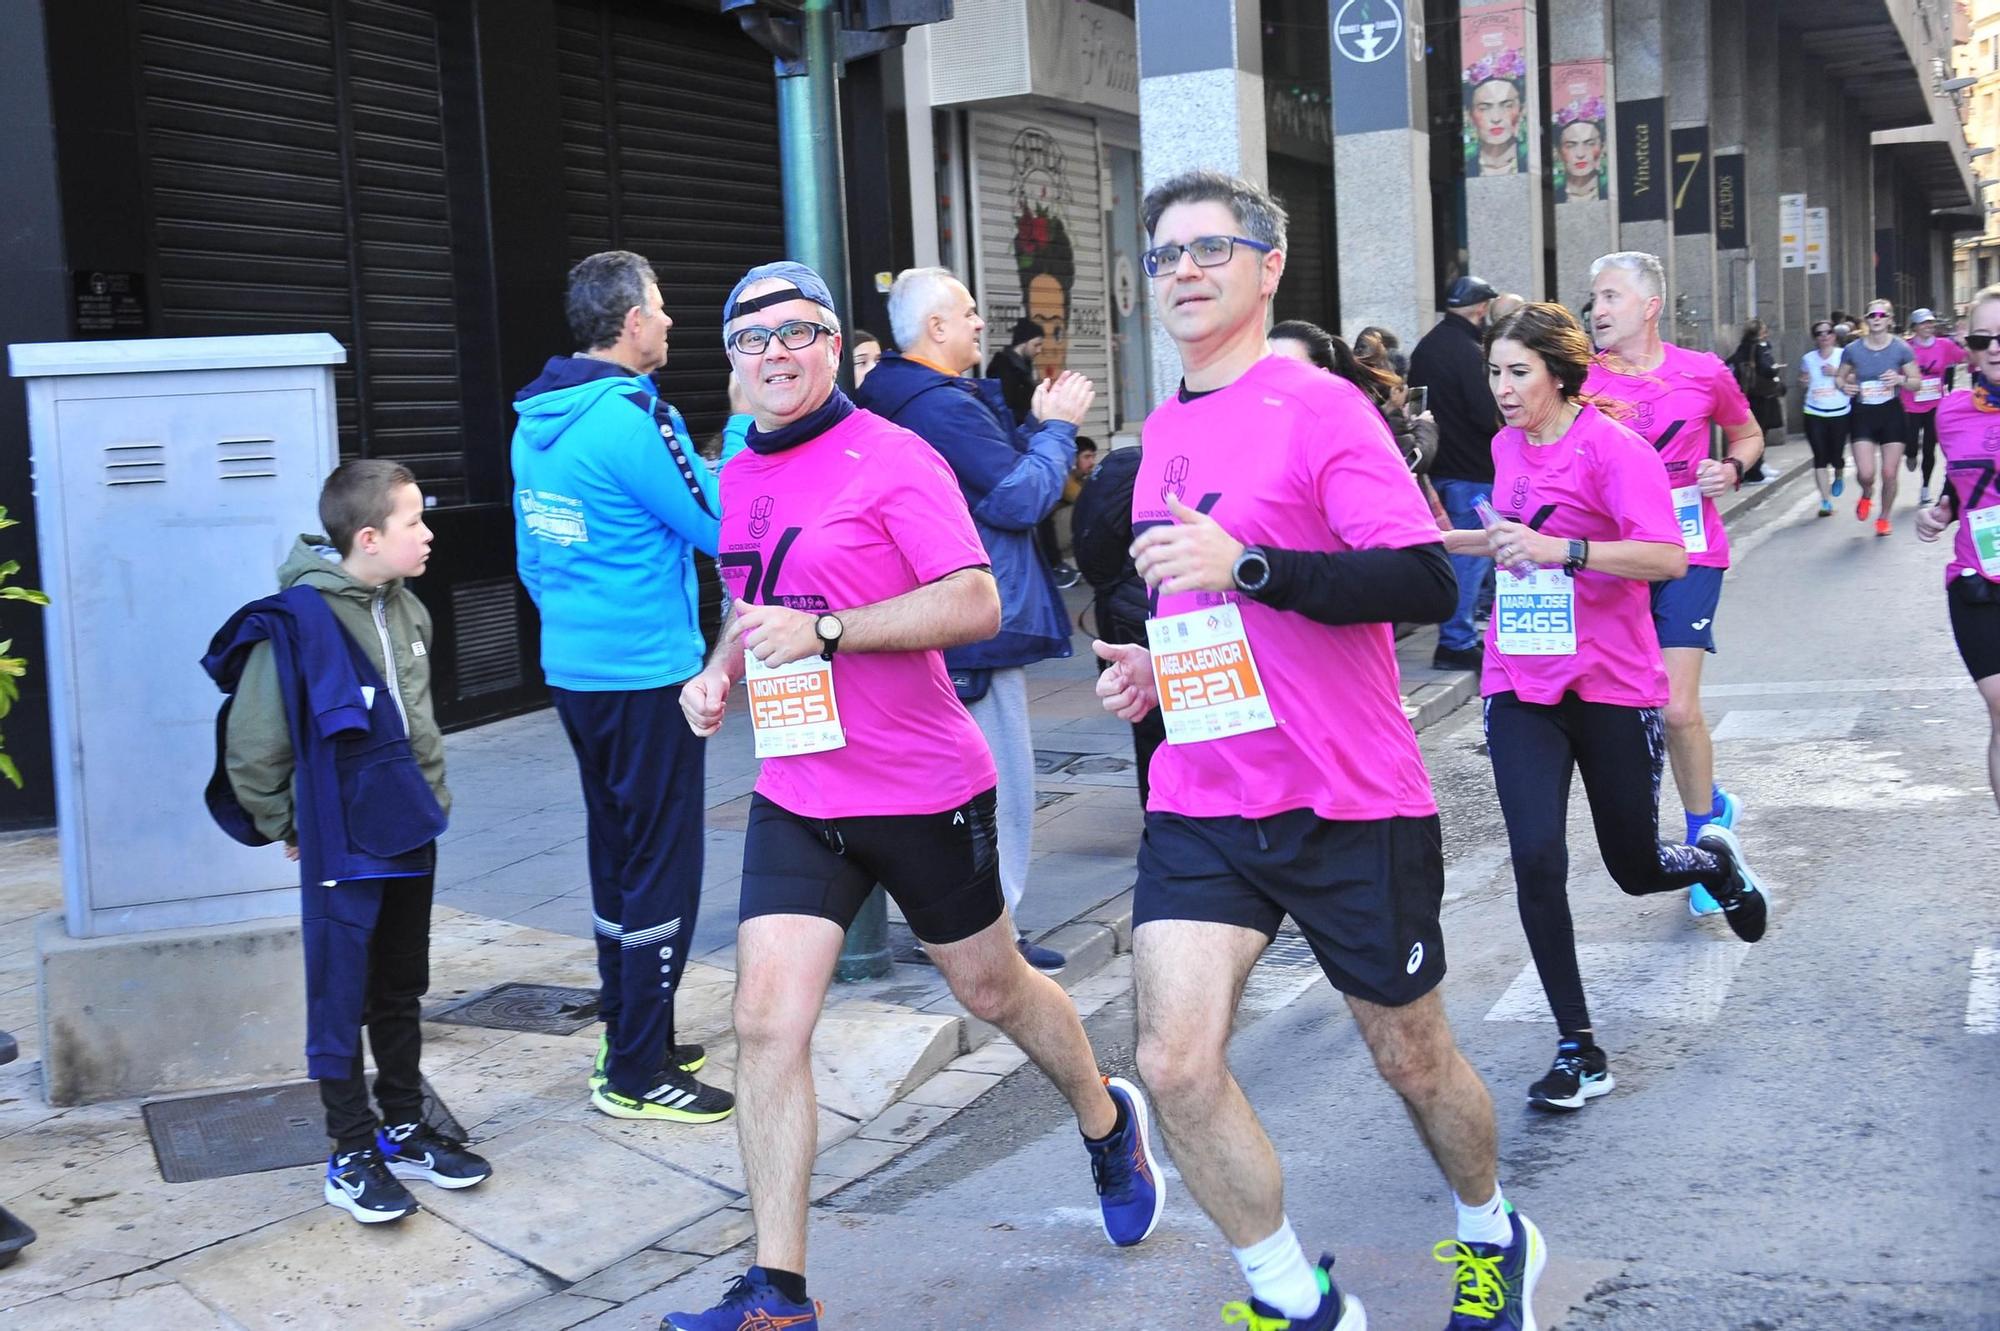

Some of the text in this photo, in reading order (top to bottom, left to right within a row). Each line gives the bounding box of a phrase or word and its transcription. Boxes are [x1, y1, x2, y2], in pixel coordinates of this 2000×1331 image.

[1633, 123, 1650, 197] Vinoteca
[1675, 152, 1702, 210] 7
[1502, 611, 1569, 633] 5465
[753, 673, 821, 698] MONTERO
[1168, 668, 1246, 711] 5221
[755, 694, 829, 729] 5255
